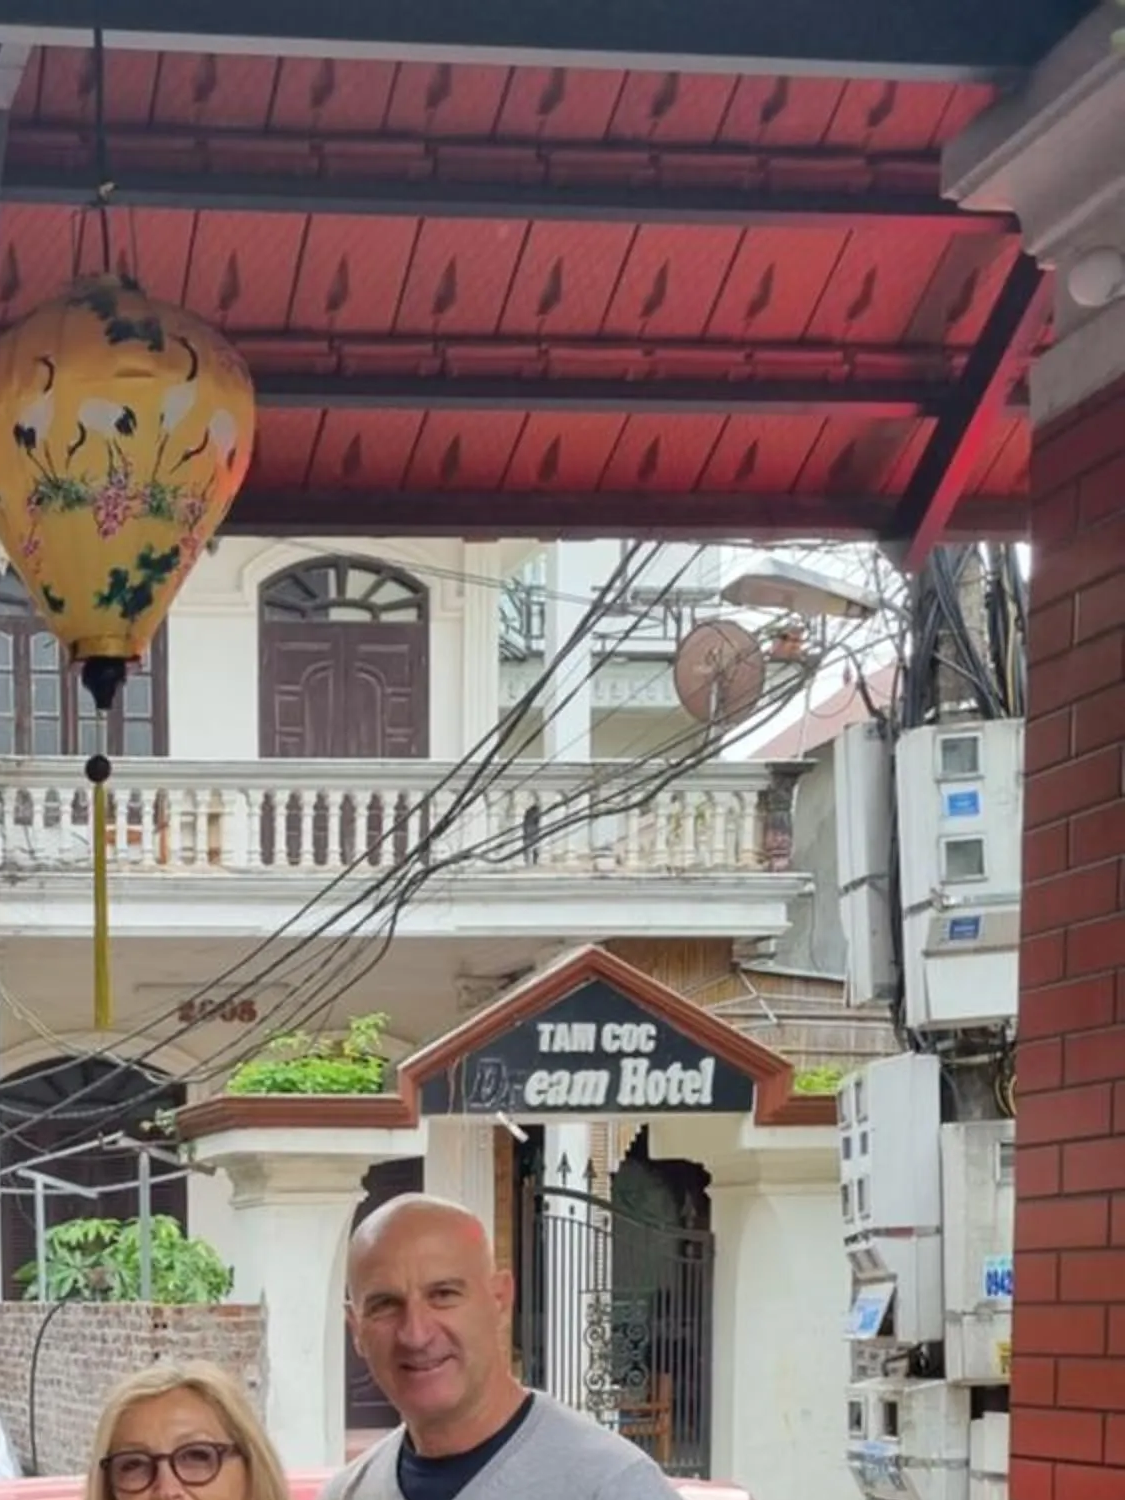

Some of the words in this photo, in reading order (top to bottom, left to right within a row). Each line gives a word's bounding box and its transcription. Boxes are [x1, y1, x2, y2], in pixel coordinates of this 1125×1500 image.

[537, 1022, 596, 1054] TAM
[600, 1021, 658, 1053] COC
[616, 1056, 716, 1106] Hotel
